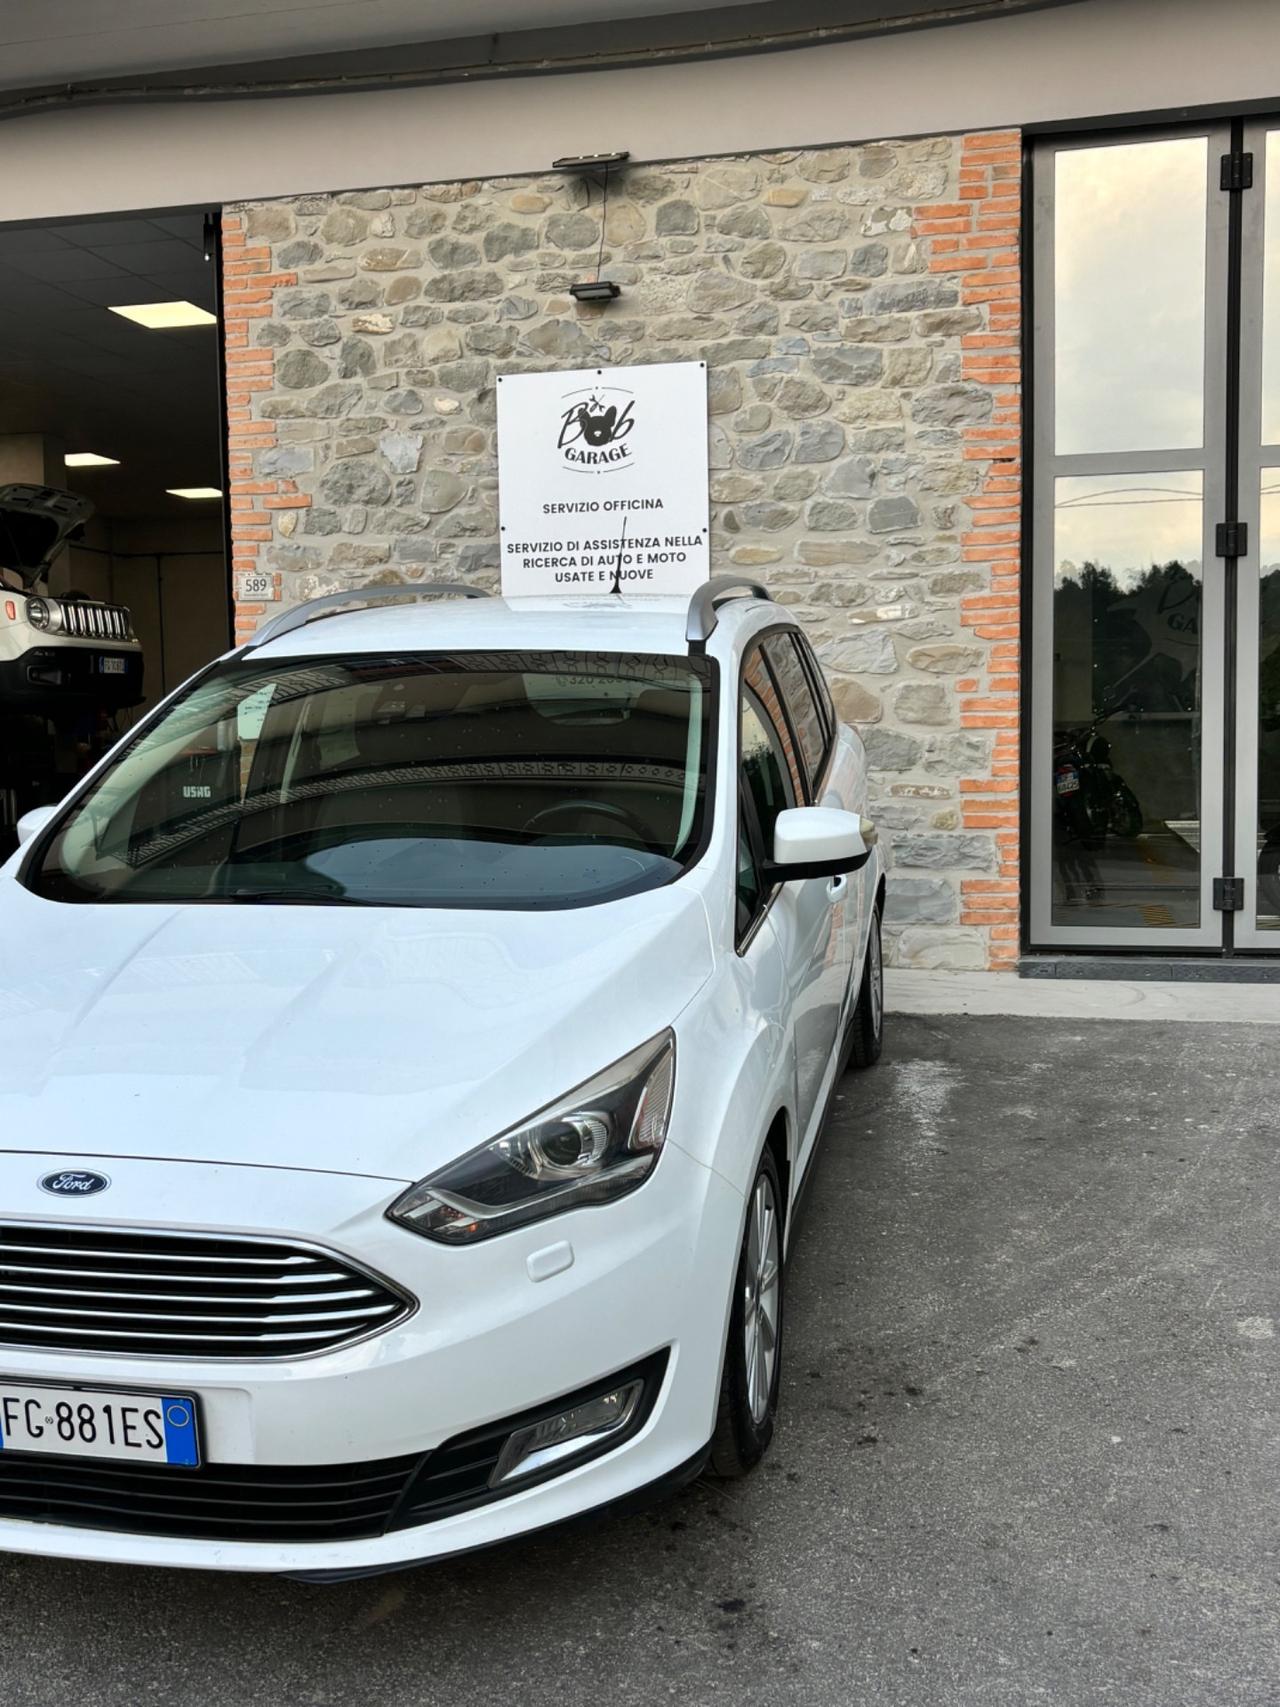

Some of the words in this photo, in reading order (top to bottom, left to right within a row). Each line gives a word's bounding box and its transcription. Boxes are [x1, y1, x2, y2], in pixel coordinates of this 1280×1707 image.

[564, 443, 632, 465] GARAGE
[542, 501, 600, 514] SERVIZIO
[603, 498, 664, 512] OFFICINA
[507, 541, 563, 554] SERVIZIO
[567, 540, 580, 551] DI
[583, 537, 661, 550] ASSISTENZA
[664, 535, 703, 547] NELLA
[523, 558, 577, 570] RICERCA
[581, 556, 594, 567] DI
[597, 554, 633, 566] AUTO
[636, 554, 643, 565] E
[647, 552, 686, 564] MOTO
[555, 572, 595, 583] USATE
[598, 571, 605, 582] E
[609, 568, 653, 581] NUOVE
[245, 578, 267, 592] 589
[183, 785, 211, 798] USAG
[52, 1173, 94, 1191] Ford
